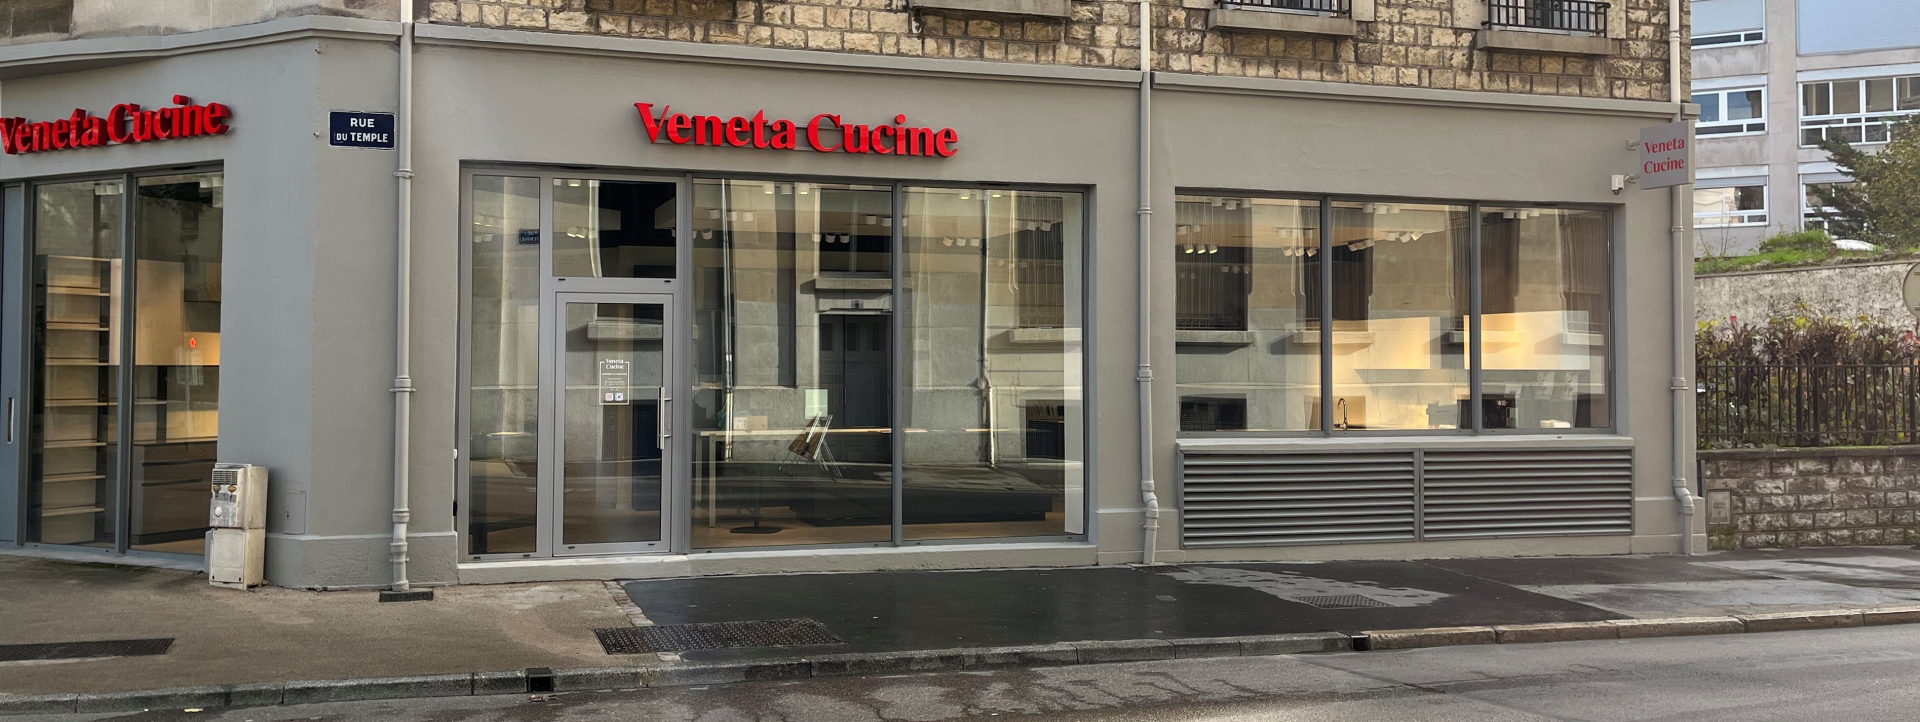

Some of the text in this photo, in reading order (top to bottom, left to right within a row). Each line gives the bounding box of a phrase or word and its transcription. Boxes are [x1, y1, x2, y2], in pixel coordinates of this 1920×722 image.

[0, 94, 231, 155] Veneta Cucine
[350, 117, 375, 128] RUE
[634, 102, 959, 157] Veneta Cucine
[336, 132, 388, 143] DU TEMPLE
[1644, 137, 1685, 154] Veneta
[1644, 157, 1684, 174] Cucine
